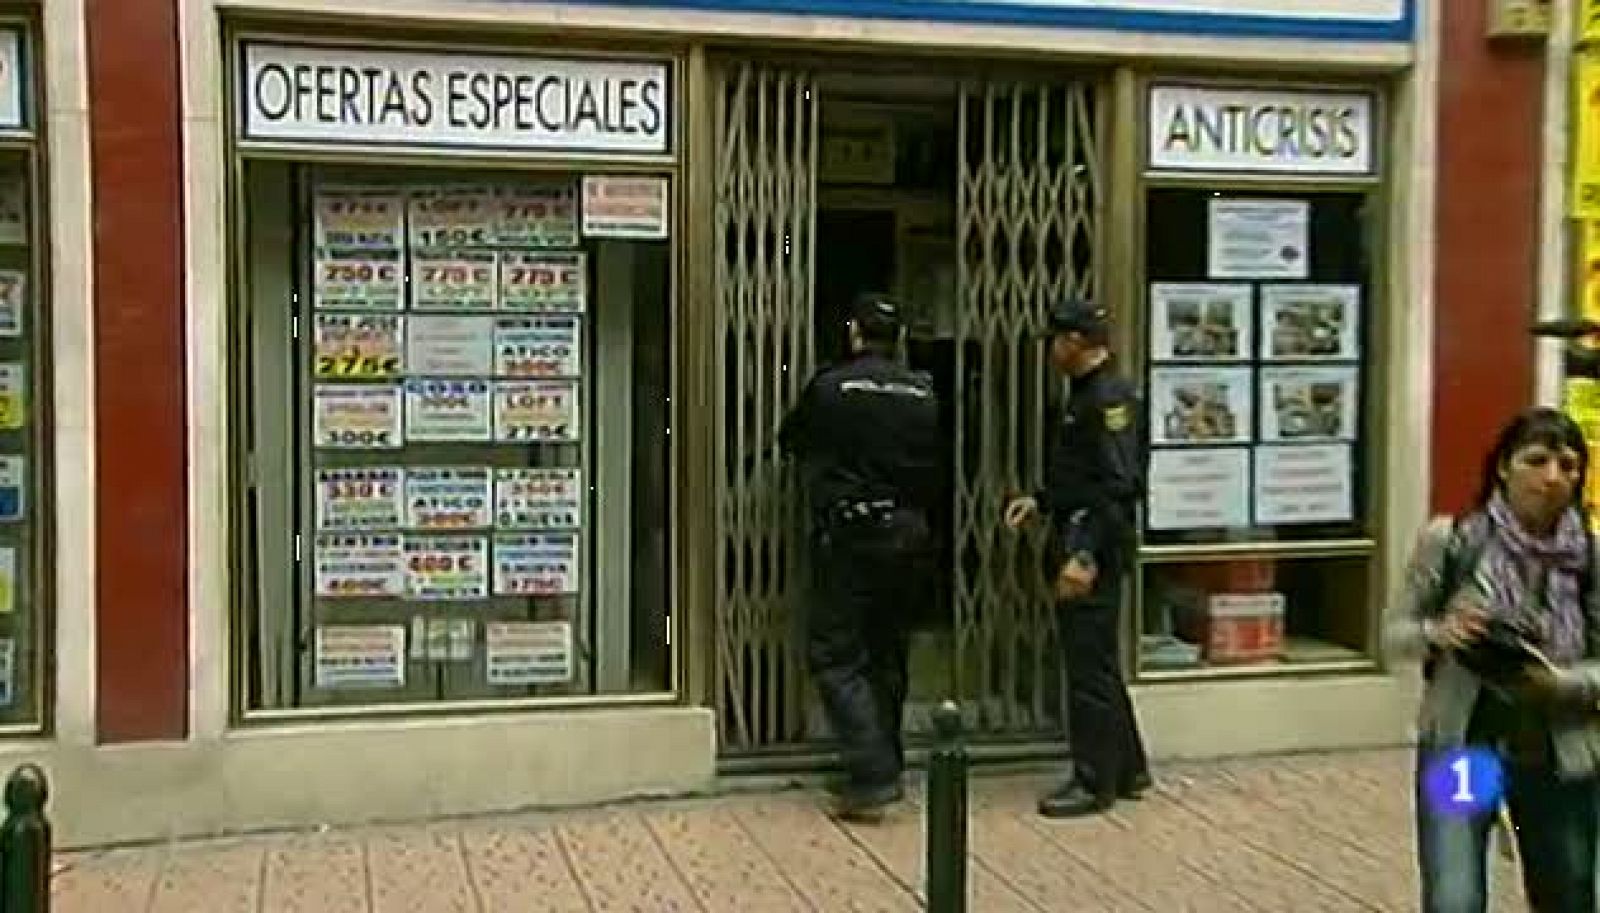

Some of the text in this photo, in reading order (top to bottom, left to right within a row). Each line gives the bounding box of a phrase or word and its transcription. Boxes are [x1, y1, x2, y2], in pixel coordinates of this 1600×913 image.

[255, 63, 661, 135] OFERTAS ESPECIALES
[1165, 104, 1360, 158] ANTICRISIS
